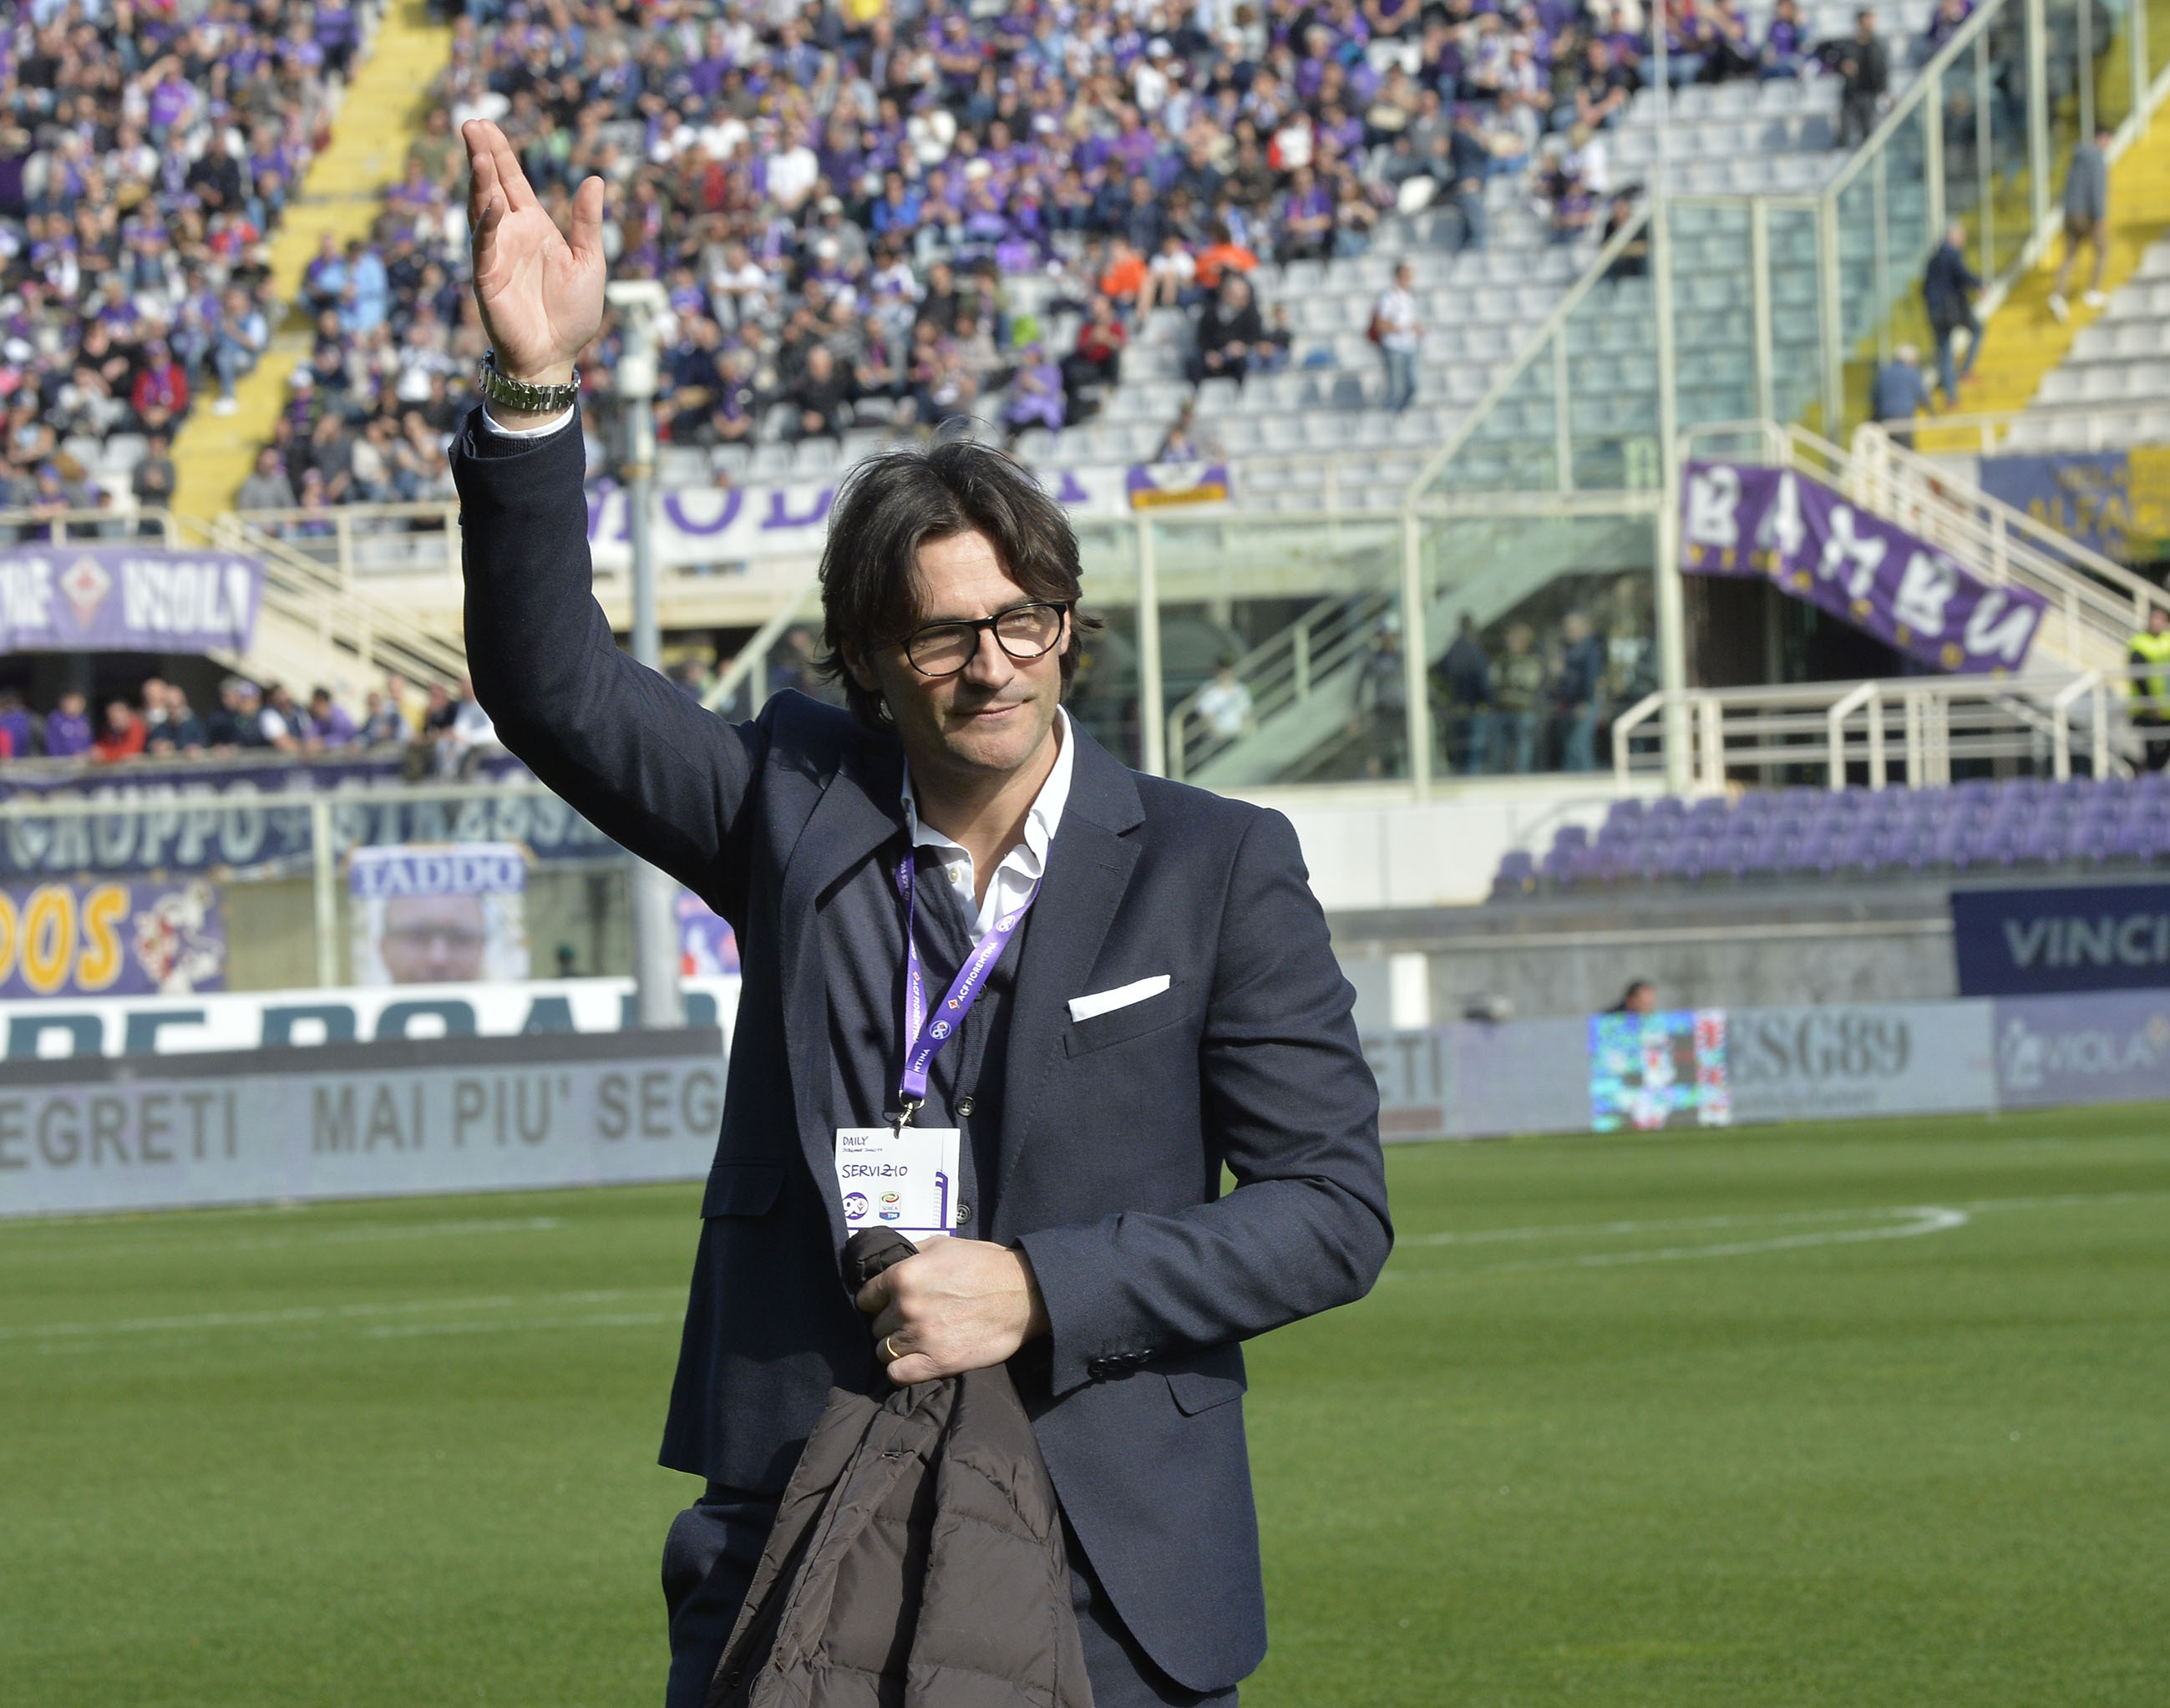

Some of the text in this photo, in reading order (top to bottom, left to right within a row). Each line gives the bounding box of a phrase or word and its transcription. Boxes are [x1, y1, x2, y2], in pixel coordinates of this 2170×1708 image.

[357, 859, 525, 896] TADDO
[0, 883, 131, 994] OS
[967, 941, 998, 986] FIORENTINA
[312, 1079, 425, 1154] MAI
[451, 1074, 573, 1150] PIU'
[843, 1136, 869, 1146] DAILY
[842, 1163, 908, 1178] SERVIZIO
